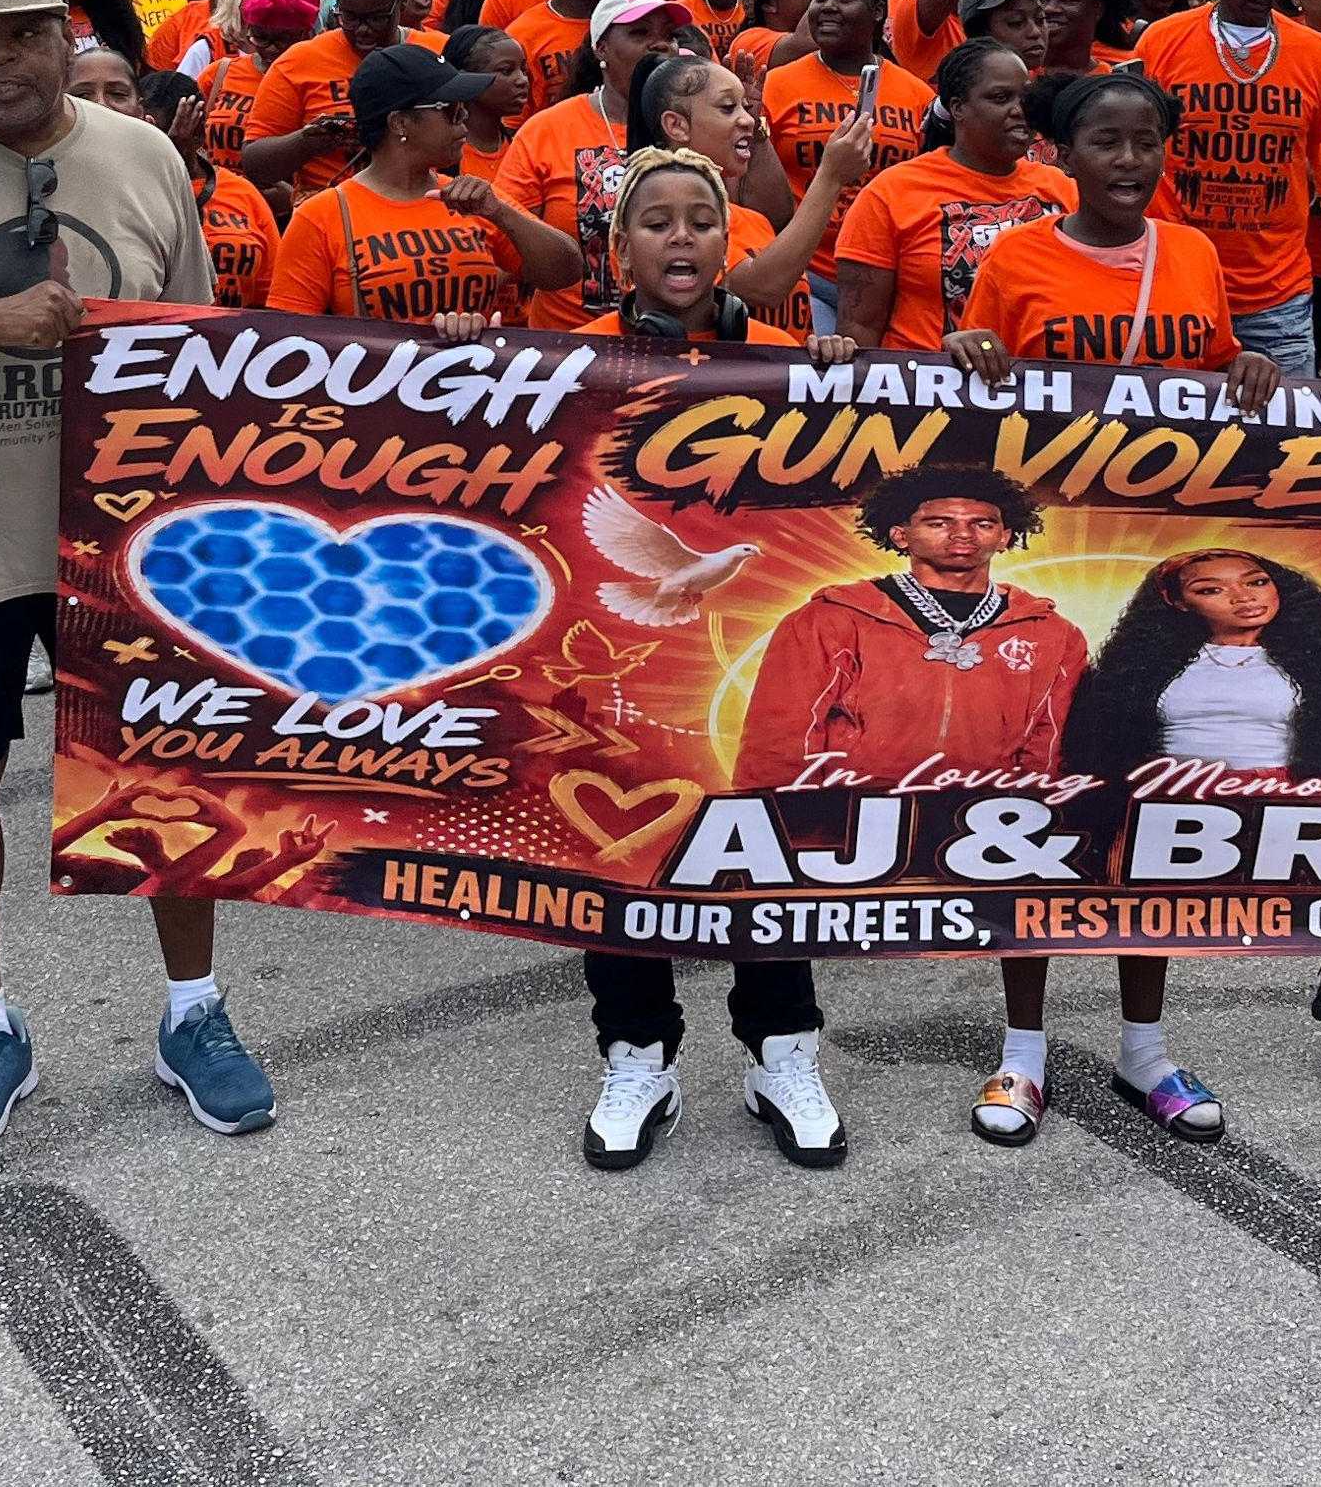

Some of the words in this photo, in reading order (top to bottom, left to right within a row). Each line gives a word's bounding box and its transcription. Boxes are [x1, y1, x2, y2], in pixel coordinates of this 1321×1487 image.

[798, 102, 916, 134] ENOGH
[1171, 82, 1302, 118] ENOUGH
[1220, 114, 1251, 131] IS
[1171, 130, 1298, 164] ENOUGH
[413, 258, 450, 277] IS
[85, 324, 586, 433] ENOUGH
[788, 363, 1072, 414] MARCH
[269, 402, 345, 432] IS
[84, 407, 564, 517] ENOUGH
[634, 394, 951, 501] GUN
[121, 677, 266, 729] WE
[271, 690, 500, 749] LOVE
[117, 725, 242, 764] YOU
[254, 735, 510, 787] ALWAYS
[775, 749, 874, 795] In
[889, 751, 1102, 805] Loving
[669, 796, 904, 887] AJ
[944, 795, 1083, 883] &
[382, 860, 606, 936] HEALING
[623, 898, 735, 945] OUR
[751, 897, 991, 947] STREETS,
[1014, 896, 1293, 942] RESTORING
